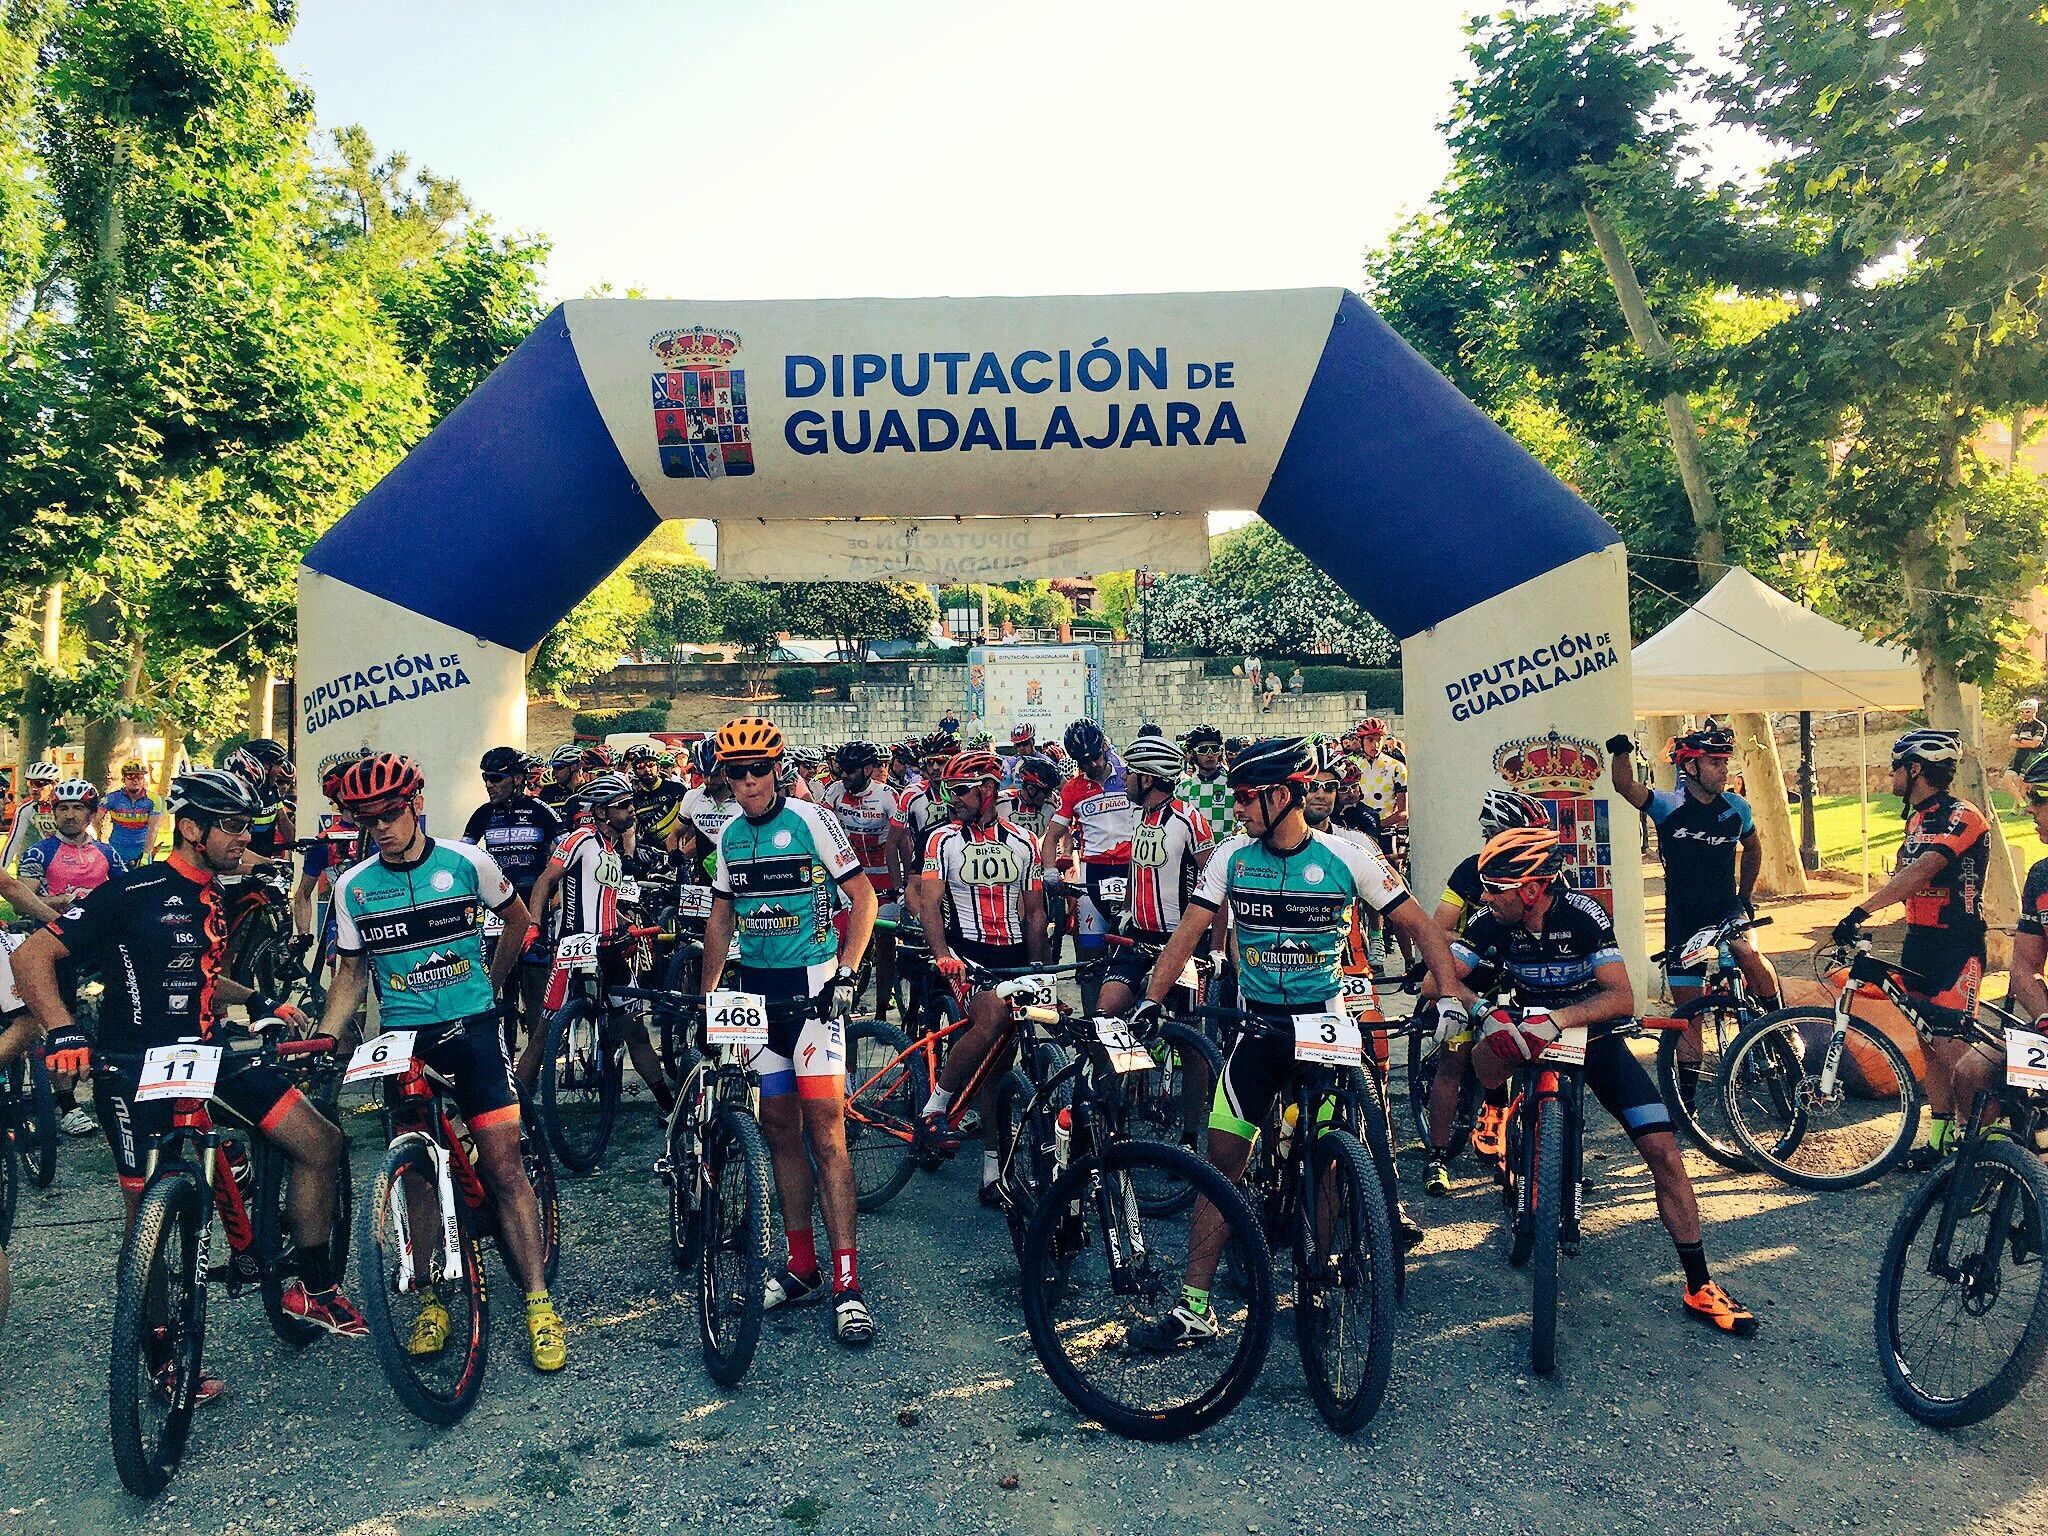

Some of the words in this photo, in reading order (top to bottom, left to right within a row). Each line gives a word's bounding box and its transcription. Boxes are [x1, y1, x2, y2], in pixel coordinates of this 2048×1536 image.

[784, 337, 1168, 399] DIPUTACIÓN
[1187, 361, 1235, 390] DE
[784, 400, 1247, 456] GUADALAJARA
[1445, 632, 1593, 703] DIPUTACIÓN
[1596, 632, 1612, 647] DE
[303, 653, 434, 715] DIPUTACIÓN
[439, 653, 461, 668] DE
[1451, 647, 1619, 722] GUADALAJARA
[306, 668, 471, 735] GUADALAJARA
[976, 847, 1001, 856] BIKES
[1134, 837, 1157, 862] 101
[763, 872, 794, 881] Humanes
[971, 857, 1010, 880] 101
[565, 876, 577, 931] SPECIALIZED
[1285, 904, 1320, 915] Gárgoles
[361, 922, 409, 942] LIDER
[428, 915, 461, 928] Pastrana
[175, 932, 194, 944] ISC
[1687, 938, 1703, 953] 28
[562, 942, 592, 958] 316
[407, 959, 471, 986] CIRCUITOMTB
[1511, 961, 1594, 978] SERAL
[119, 944, 142, 1025] musebikes.com
[715, 1007, 761, 1027] 468
[1320, 1023, 1337, 1044] 3
[371, 1045, 388, 1062] 6
[2027, 1047, 2048, 1069] 2
[164, 1061, 195, 1080] 11
[1574, 1182, 1583, 1220] ROCKSHOX
[447, 1215, 460, 1253] ROCKSHOX
[471, 1238, 487, 1302] MAXXIS
